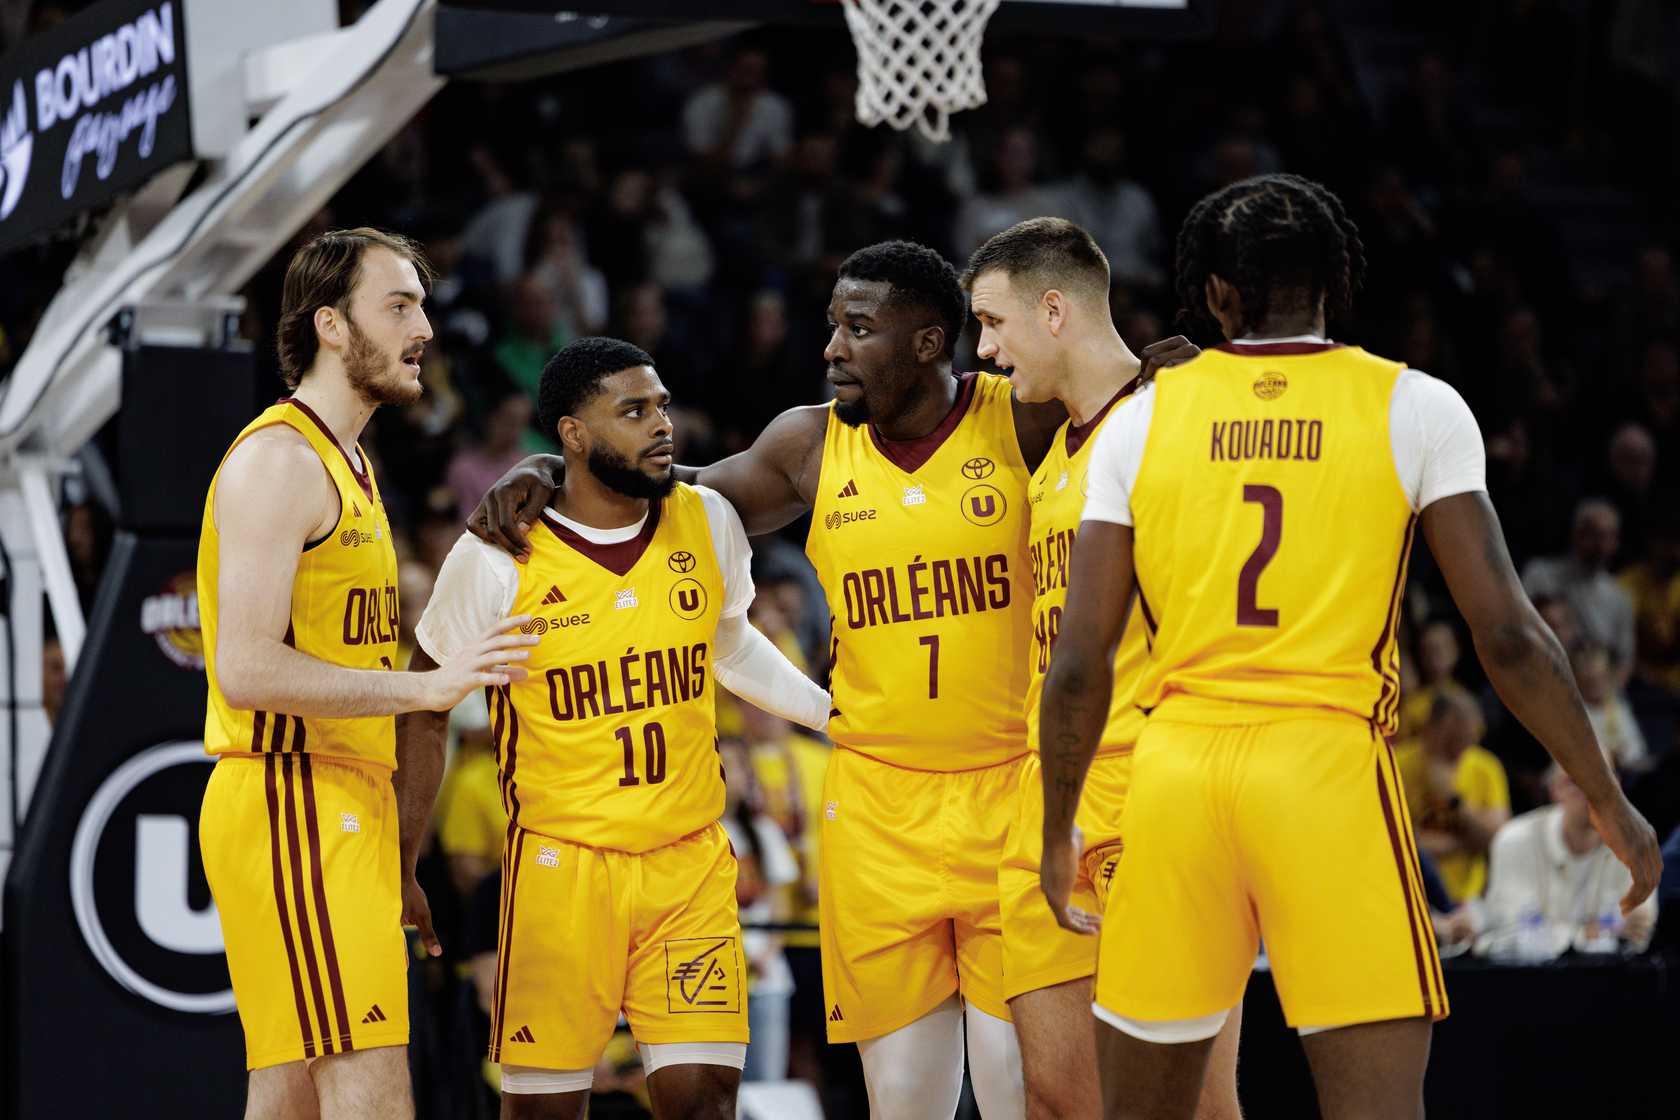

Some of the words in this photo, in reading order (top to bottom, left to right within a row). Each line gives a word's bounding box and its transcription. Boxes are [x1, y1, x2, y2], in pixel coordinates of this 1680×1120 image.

[36, 1, 175, 133] BOURDIN
[1210, 419, 1323, 462] KOUADIO
[842, 509, 877, 524] suez
[971, 495, 996, 518] U
[1236, 483, 1284, 628] 2
[550, 613, 591, 630] suez
[678, 588, 700, 612] U
[842, 553, 1011, 630] ORLÉANS
[545, 642, 708, 722] ORLÉANS
[918, 634, 940, 700] 7
[614, 721, 667, 787] 10
